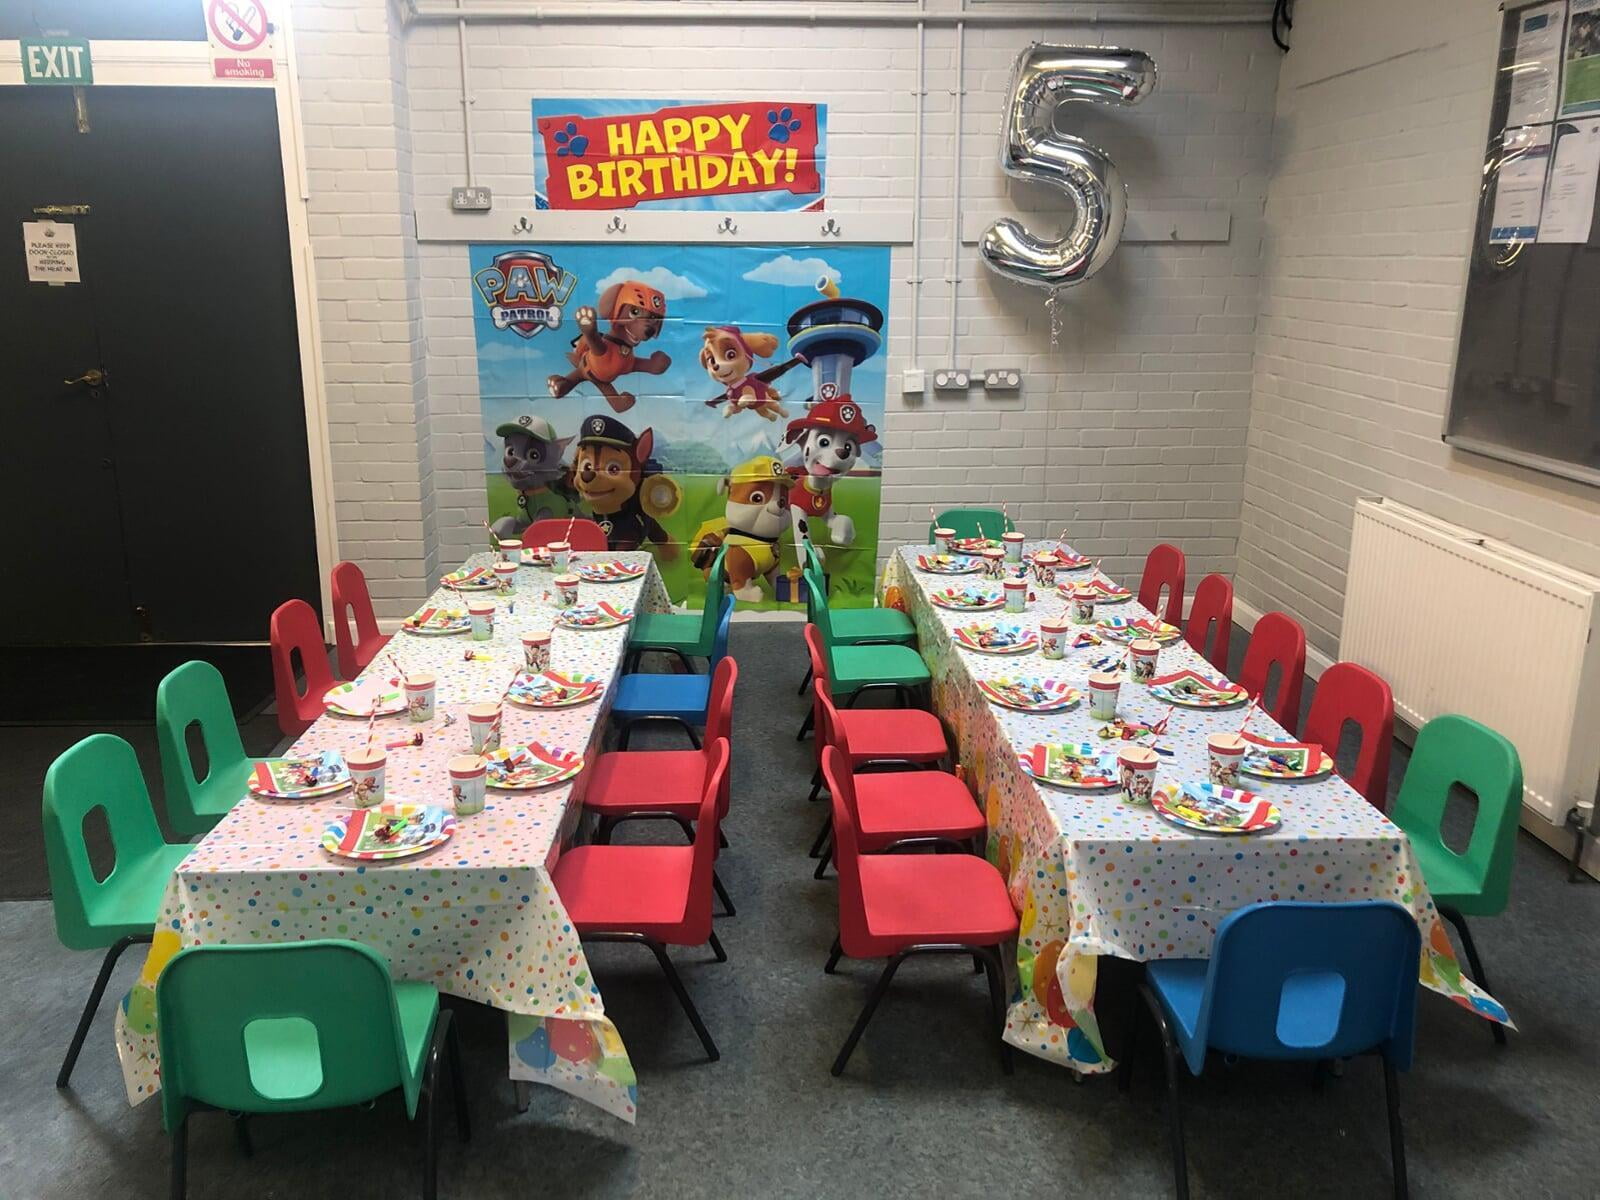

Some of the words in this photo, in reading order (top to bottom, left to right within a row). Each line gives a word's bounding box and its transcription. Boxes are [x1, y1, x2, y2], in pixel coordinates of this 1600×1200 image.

[27, 45, 84, 79] EXIT
[224, 68, 265, 78] smoking
[237, 58, 250, 68] No
[606, 113, 751, 157] HAPPY
[566, 148, 799, 201] BIRTHDAY!
[977, 41, 1158, 289] 5
[473, 265, 578, 307] PAW
[500, 309, 554, 322] PATROL
